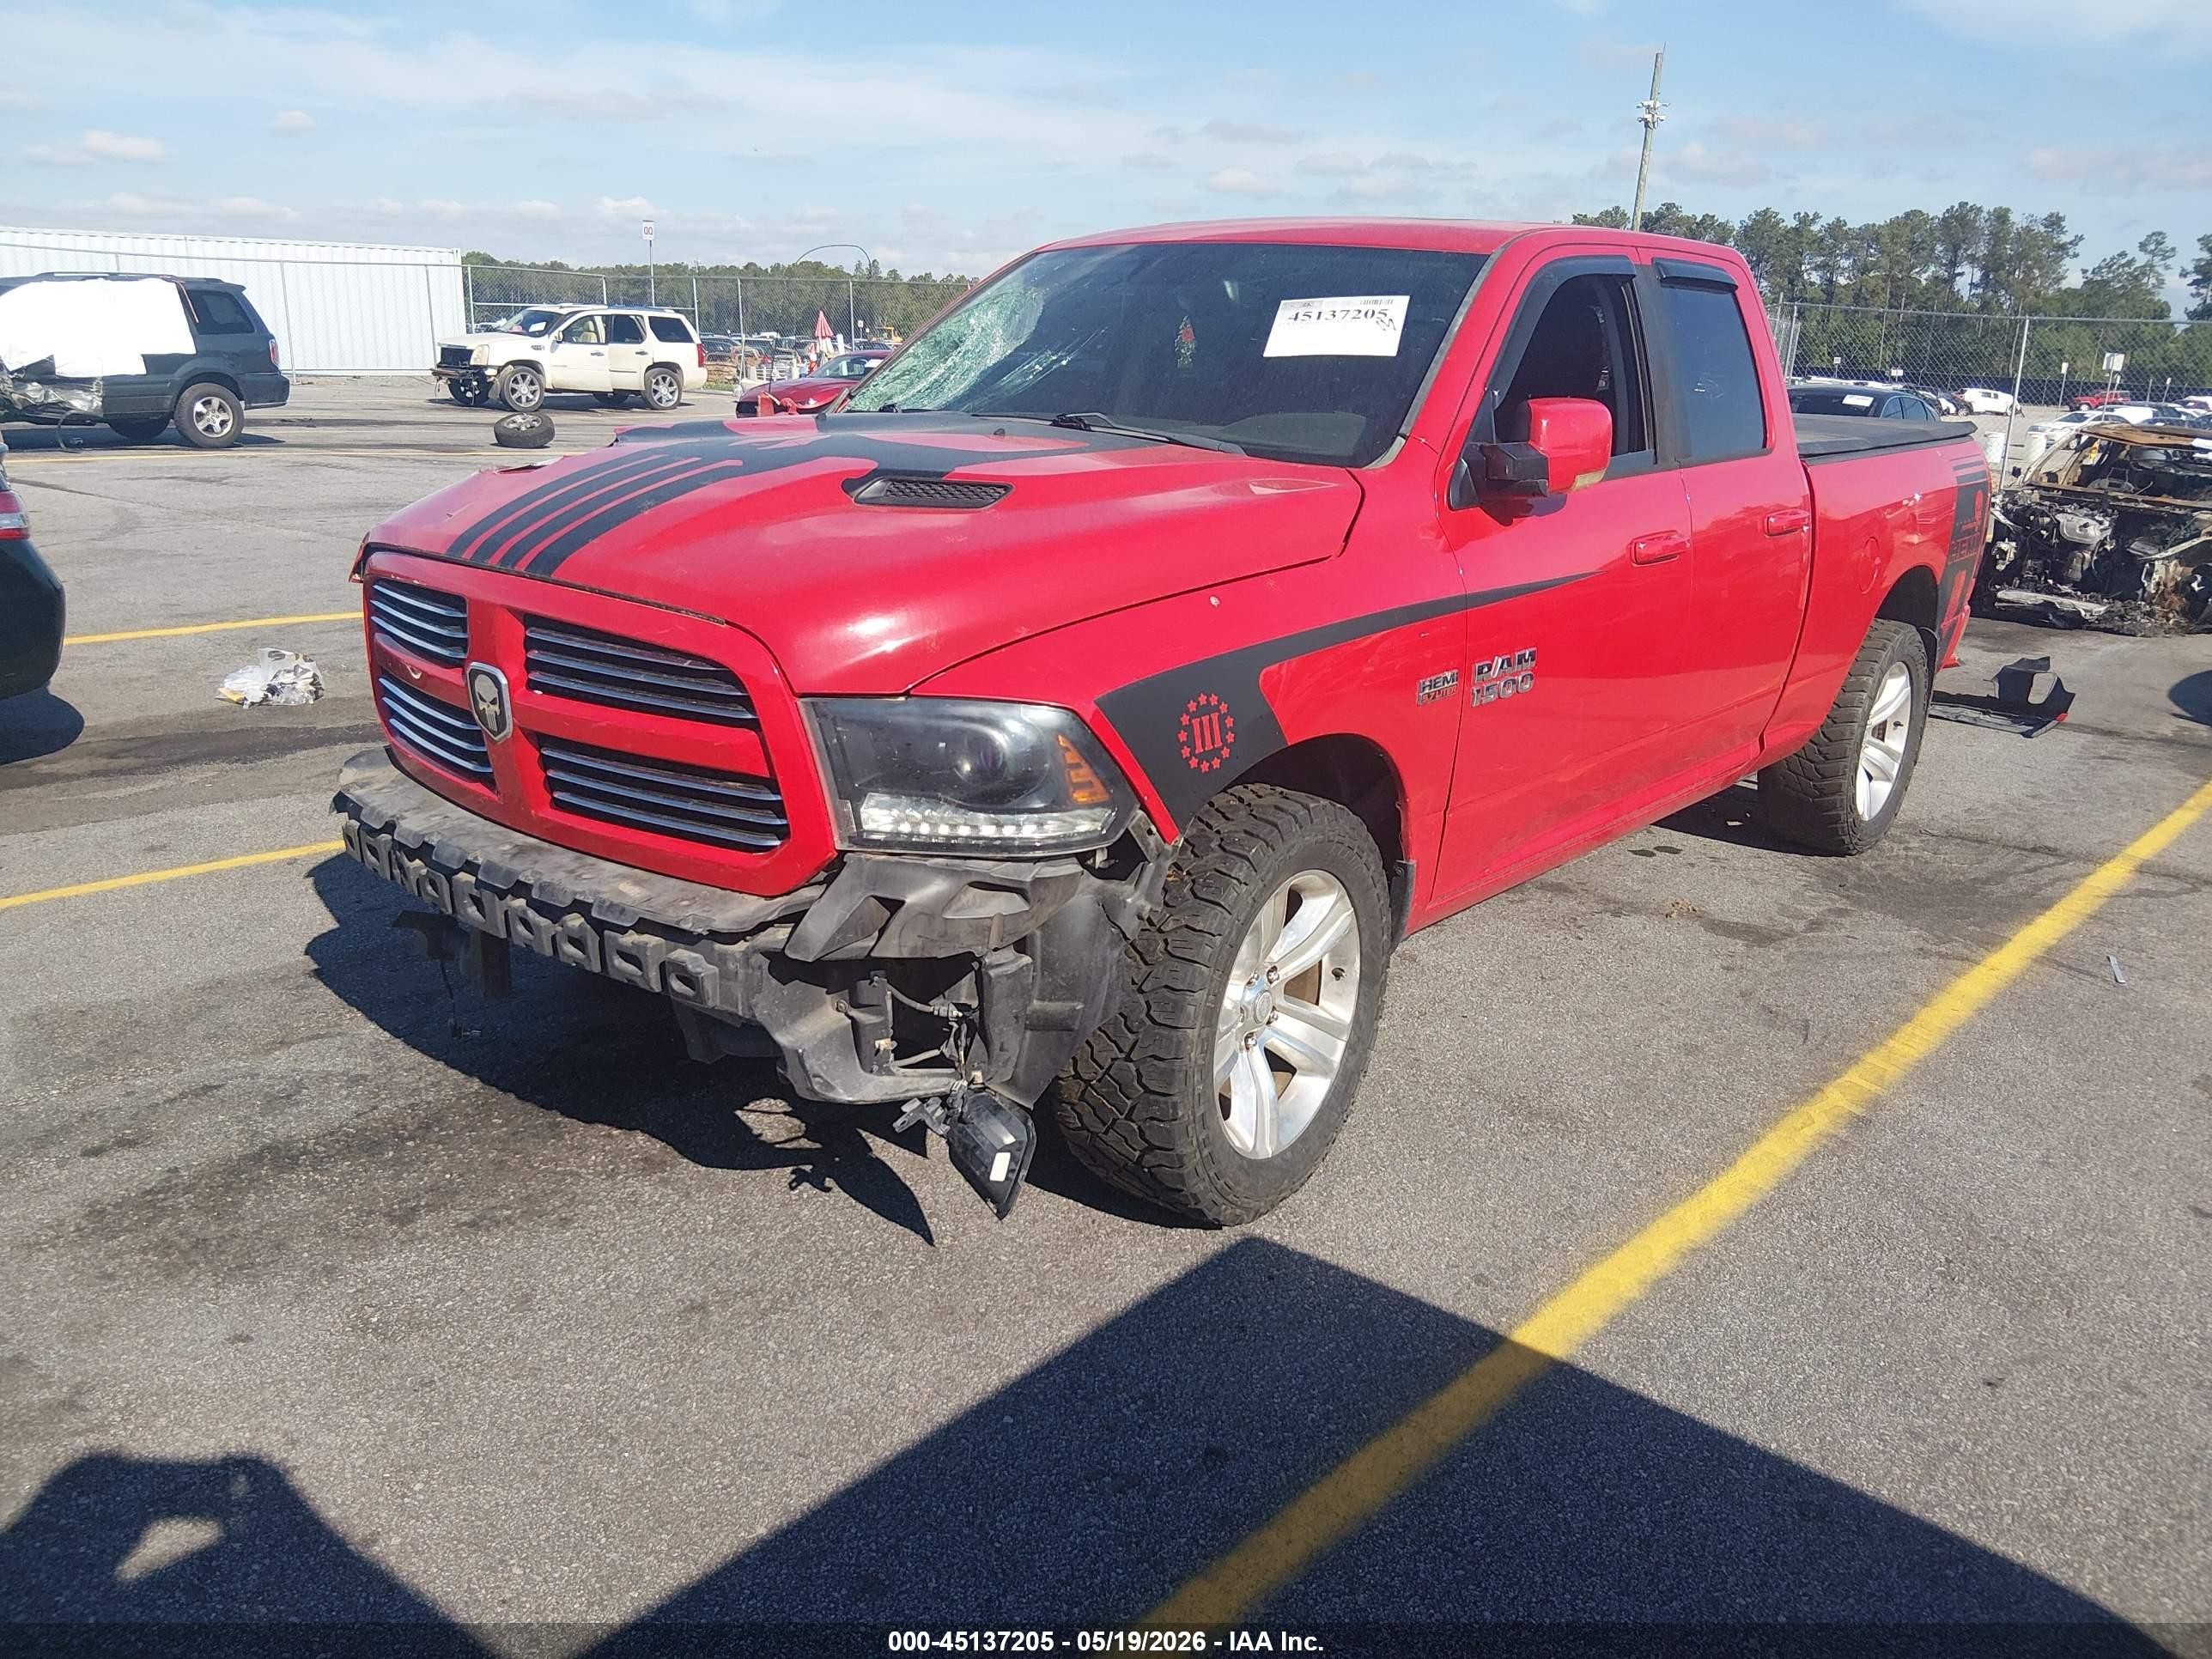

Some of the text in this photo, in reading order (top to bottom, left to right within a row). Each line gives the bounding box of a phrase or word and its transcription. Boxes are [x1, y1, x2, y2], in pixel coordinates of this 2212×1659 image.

[1287, 308, 1389, 322] 45137205
[1419, 670, 1458, 693] HEMI
[1471, 672, 1534, 708] 1500
